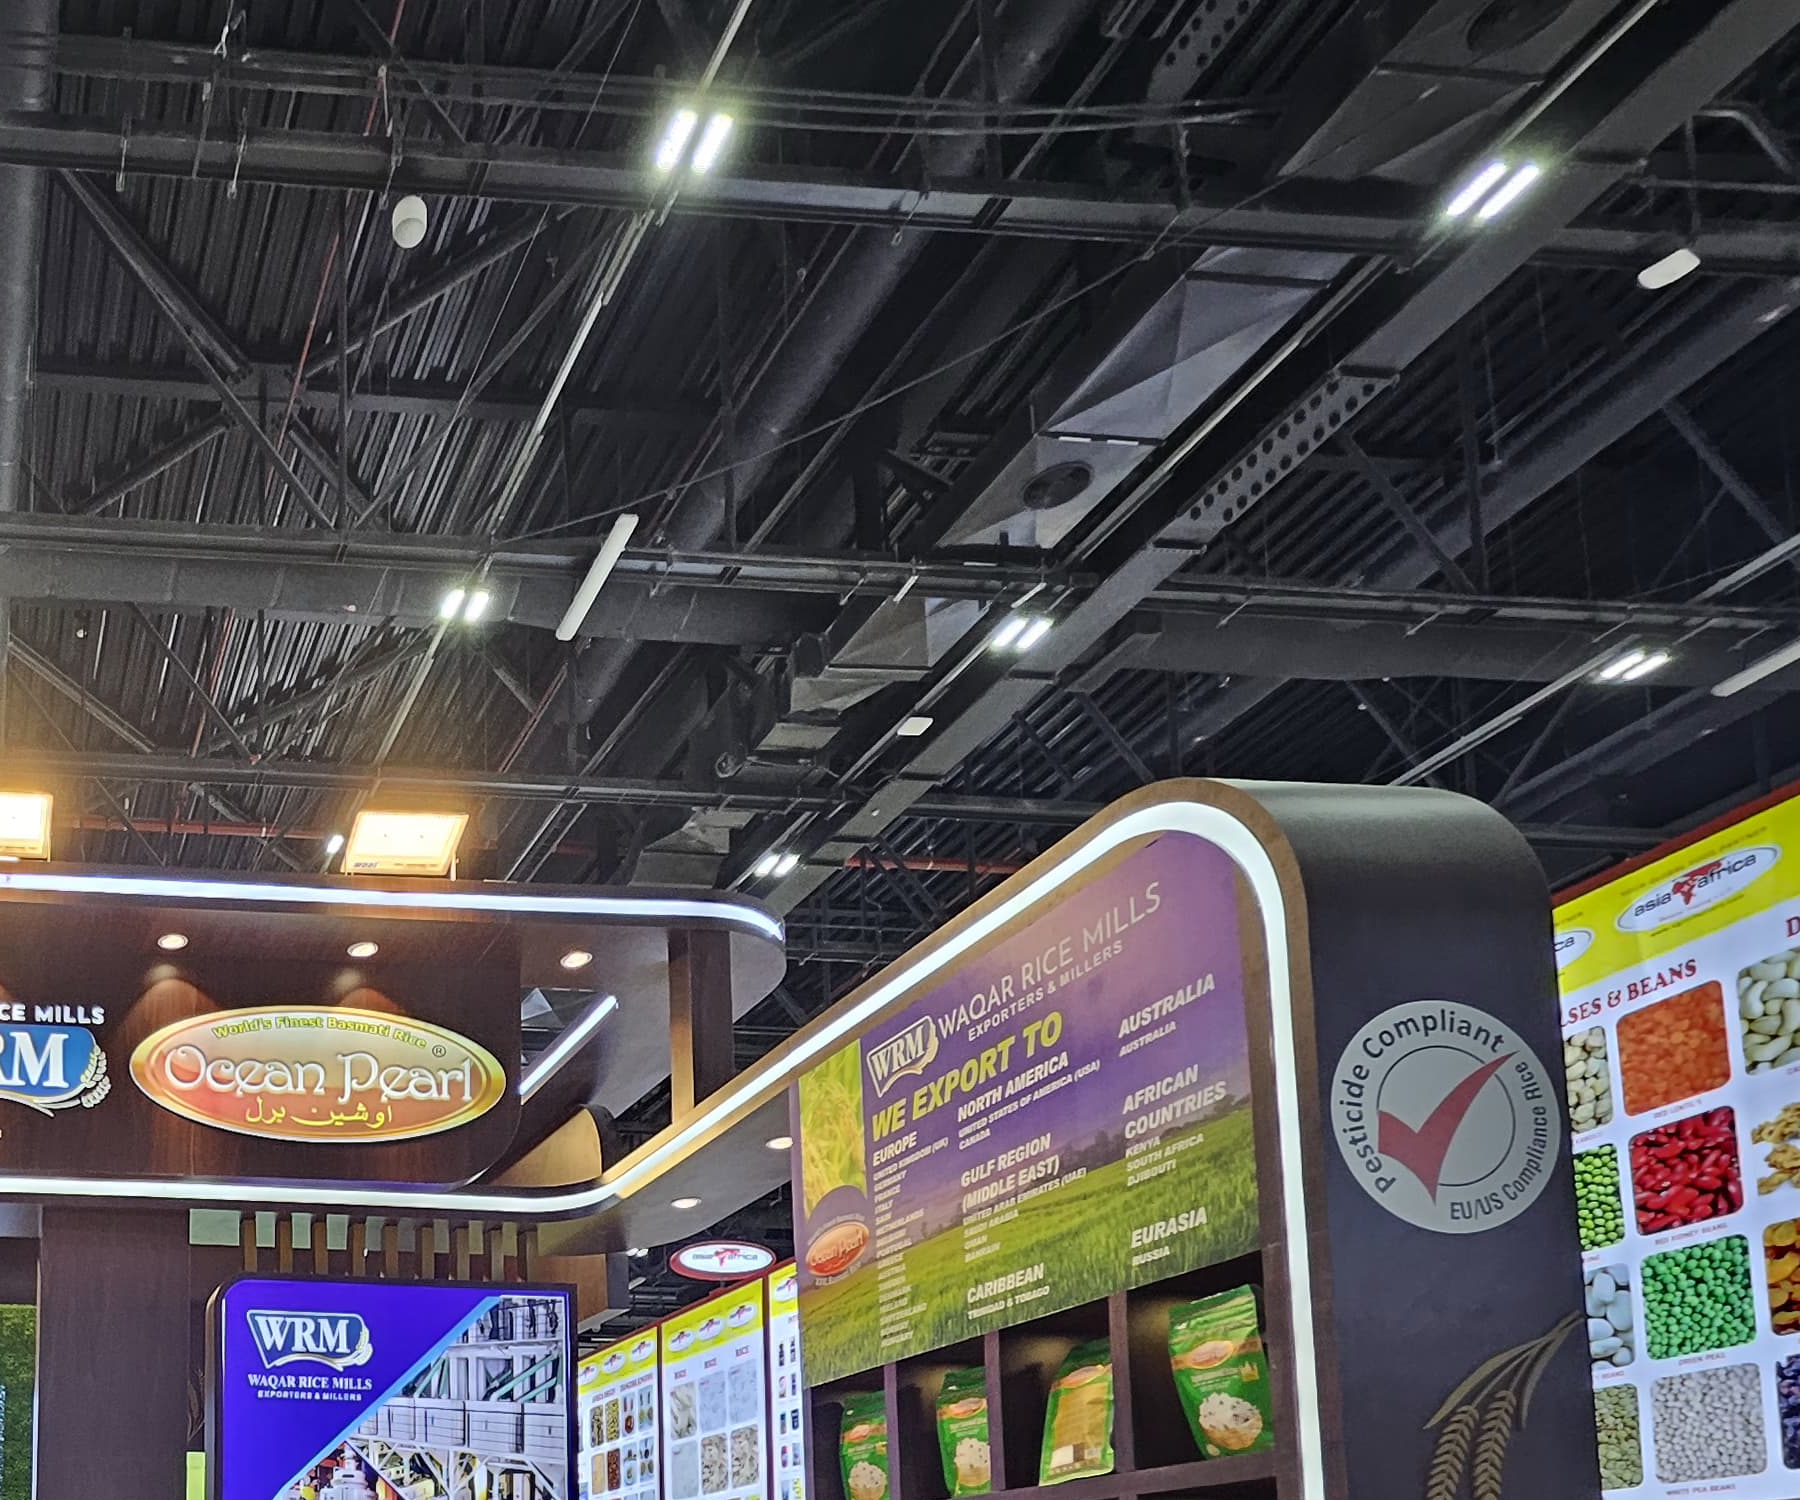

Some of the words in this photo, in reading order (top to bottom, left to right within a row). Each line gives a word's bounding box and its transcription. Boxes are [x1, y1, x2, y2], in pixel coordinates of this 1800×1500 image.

[1634, 891, 1672, 916] asia
[1697, 854, 1757, 888] africa
[938, 975, 1014, 1038] WAQAR
[1021, 936, 1073, 990] RICE
[1082, 882, 1161, 952] MILLS
[1626, 957, 1697, 1002] BEANS
[968, 987, 1044, 1041] EXPORTERS
[1060, 940, 1123, 987] MILLERS
[1119, 974, 1215, 1039] AUSTRALIA
[35, 1004, 105, 1025] MILLS
[212, 1014, 272, 1038] World's
[276, 1013, 322, 1030] Finest
[326, 1016, 390, 1038] Basmati
[394, 1027, 427, 1050] Rice
[1362, 1008, 1505, 1058] Compliant
[871, 1023, 925, 1081] WRM
[1119, 1021, 1176, 1057] AUSTRALIA
[163, 1044, 326, 1096] Ocean
[336, 1051, 474, 1104] Pearl
[872, 1099, 906, 1142] WE
[912, 1036, 1015, 1120] EXPORT
[1023, 1011, 1062, 1057] TO
[958, 1085, 1002, 1122] NORTH
[1005, 1051, 1068, 1098] AMERICA
[1122, 1064, 1199, 1115] AFRICAN
[1514, 1061, 1543, 1101] Rice
[1125, 1080, 1227, 1139] COUNTRIES
[1339, 1065, 1396, 1194] Pesticide
[873, 1131, 917, 1167] EUROPE
[961, 1159, 995, 1187] GULF
[998, 1133, 1051, 1171] REGION
[1126, 1136, 1161, 1157] KENYA
[1126, 1150, 1162, 1172] SOUTH
[1164, 1133, 1204, 1157] AFRICA
[1501, 1105, 1548, 1201] Compliance
[962, 1174, 1016, 1213] (MIDDLE
[1018, 1155, 1060, 1186] EAST)
[1450, 1191, 1504, 1220] EU/US
[1131, 1207, 1207, 1249] EURASIA
[1132, 1246, 1170, 1266] RUSSIA
[967, 1262, 1044, 1304] CARIBBEAN
[255, 1316, 350, 1354] WRM
[248, 1374, 299, 1389] WAQAR
[300, 1375, 328, 1390] RICE
[332, 1376, 372, 1391] MILLS
[257, 1390, 310, 1400] EXPORTERS
